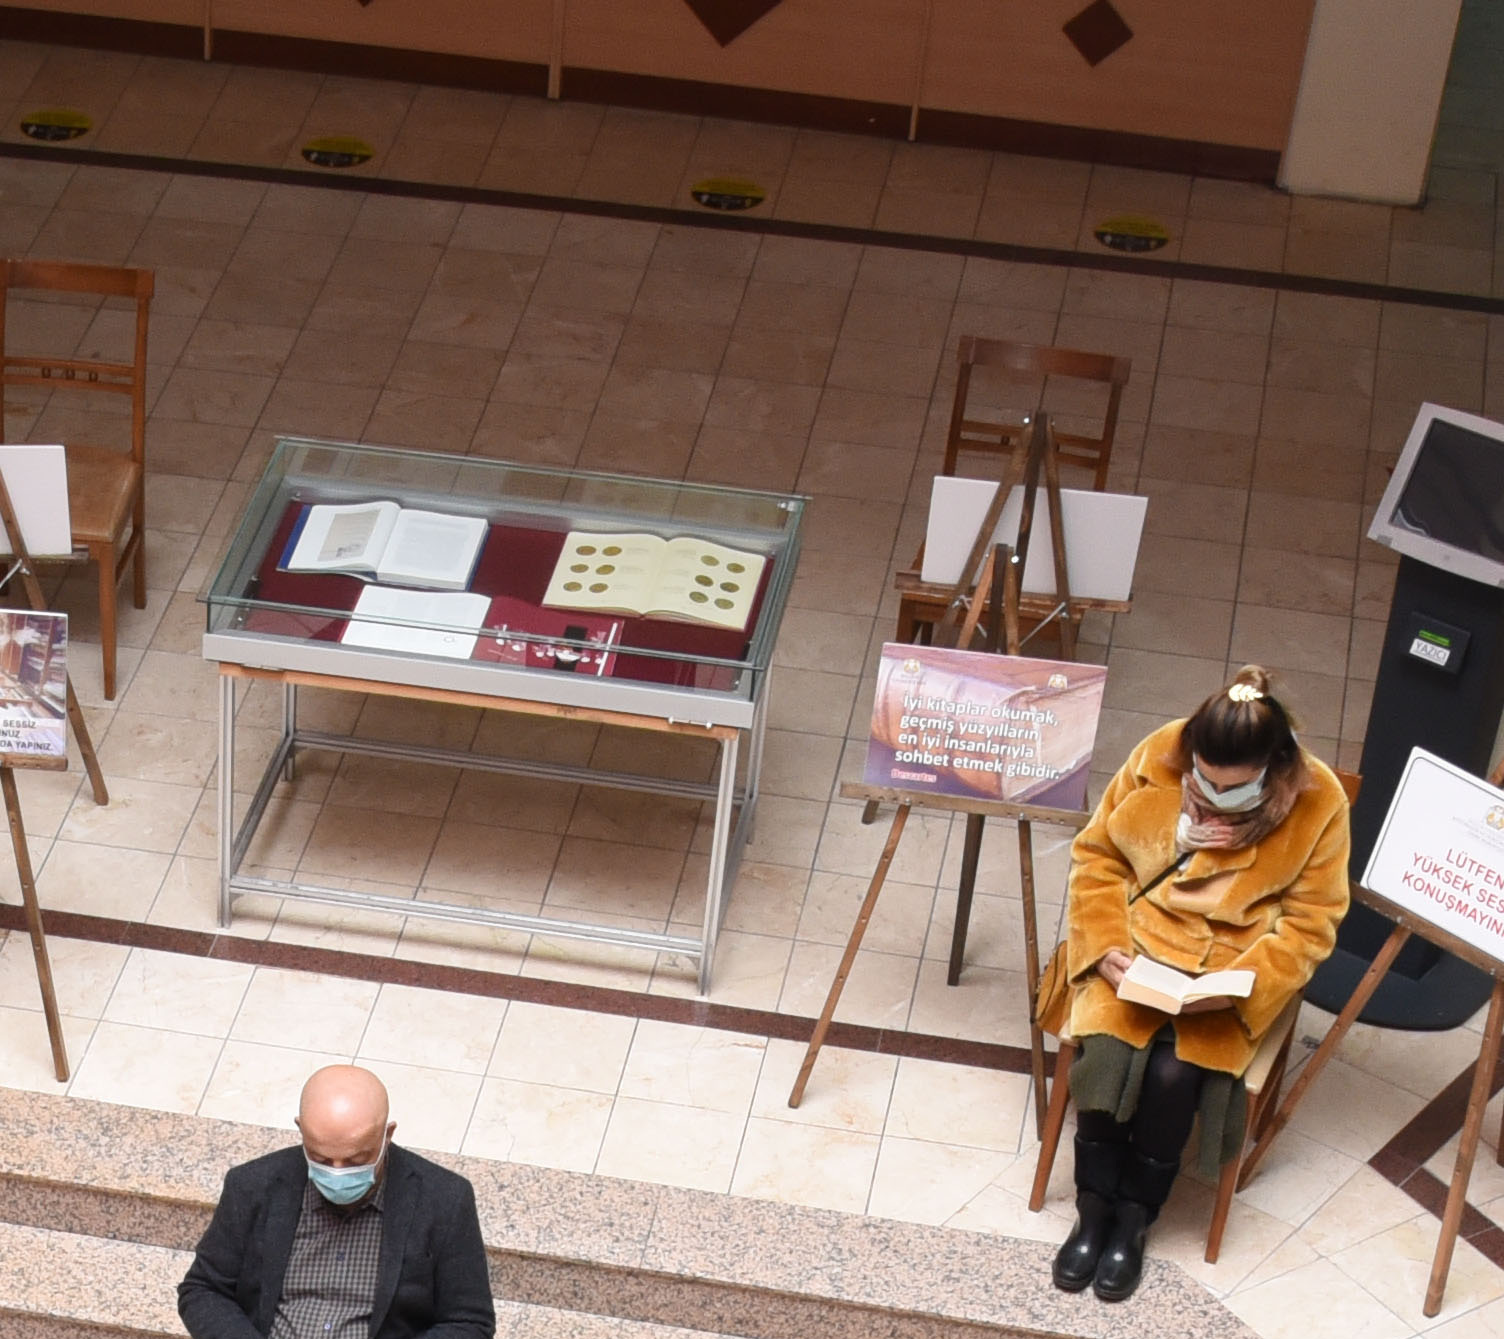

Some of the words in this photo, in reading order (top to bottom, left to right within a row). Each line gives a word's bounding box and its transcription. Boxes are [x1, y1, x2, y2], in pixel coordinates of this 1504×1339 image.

[902, 691, 923, 710] İyi
[926, 696, 987, 718] kitaplar
[990, 704, 1060, 726] okumak,
[899, 712, 955, 734] geçmiş
[958, 718, 1040, 742] yüzyılların
[897, 733, 917, 745] en
[921, 732, 941, 749] iyi
[944, 735, 1034, 760] insanlarıyla
[894, 748, 949, 767] sohbet
[952, 754, 1003, 773] etmek
[1005, 760, 1061, 783] gibidir.
[1409, 848, 1476, 897] YÜKSEK
